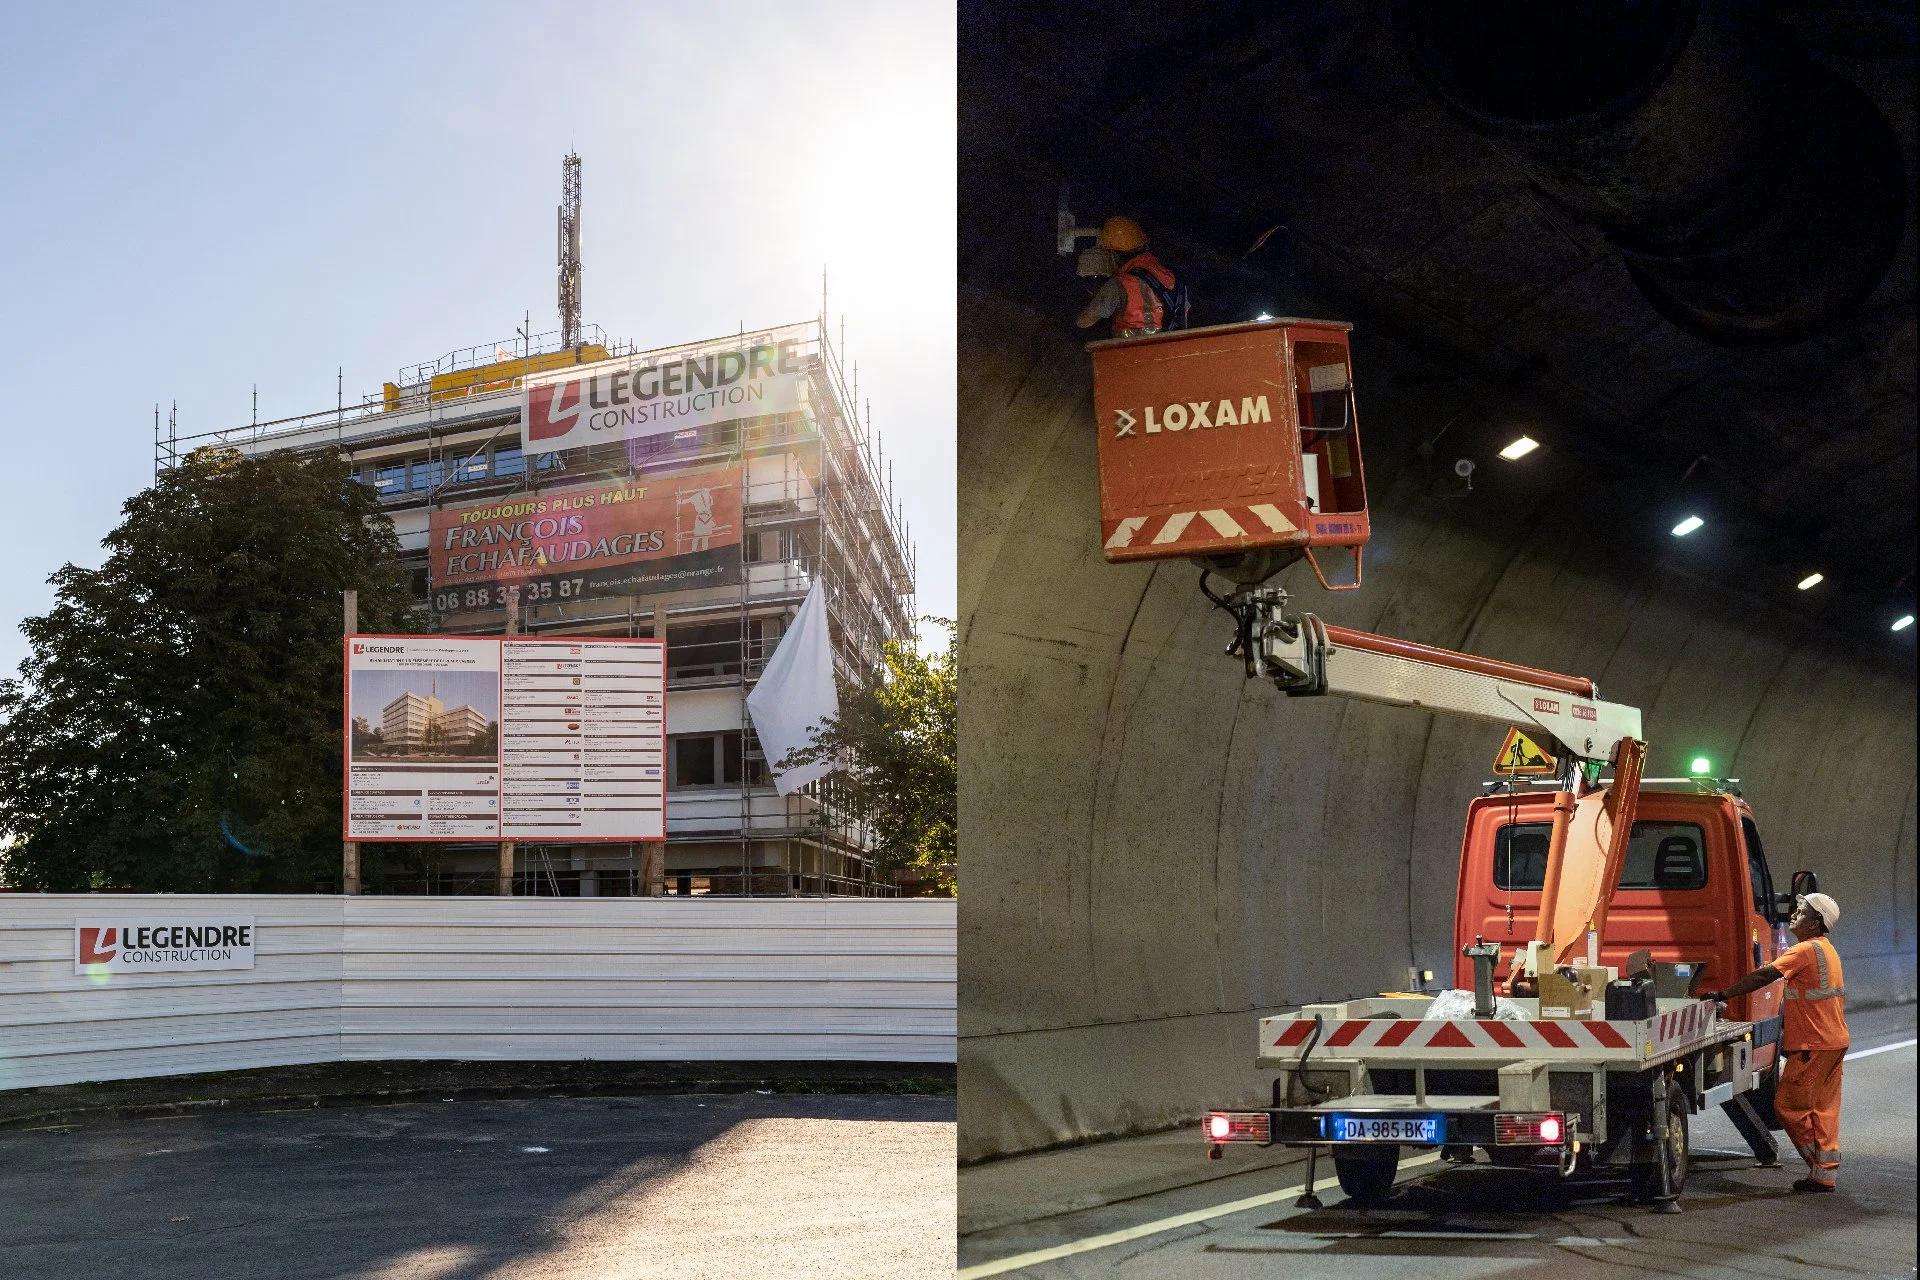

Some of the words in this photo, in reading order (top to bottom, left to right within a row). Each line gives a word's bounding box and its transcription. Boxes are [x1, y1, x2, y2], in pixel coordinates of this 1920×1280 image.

[589, 337, 800, 409] LEGENDRE
[589, 382, 763, 431] CONSTRUCTION
[1144, 395, 1272, 434] LOXAM
[460, 501, 547, 525] TOUJOURS
[552, 494, 595, 512] PLUS
[600, 486, 649, 505] HAUT
[443, 514, 585, 551] FRANÇOIS
[445, 530, 665, 577] ECHAFAUDAGES
[436, 592, 459, 611] 06
[465, 588, 489, 607] 88
[496, 585, 520, 604] 35
[528, 582, 552, 600] 35
[559, 578, 584, 597] 87
[365, 646, 405, 654] LEGENDRE
[122, 925, 251, 949] LEGENDRE
[122, 949, 231, 964] CONSTRUCTION
